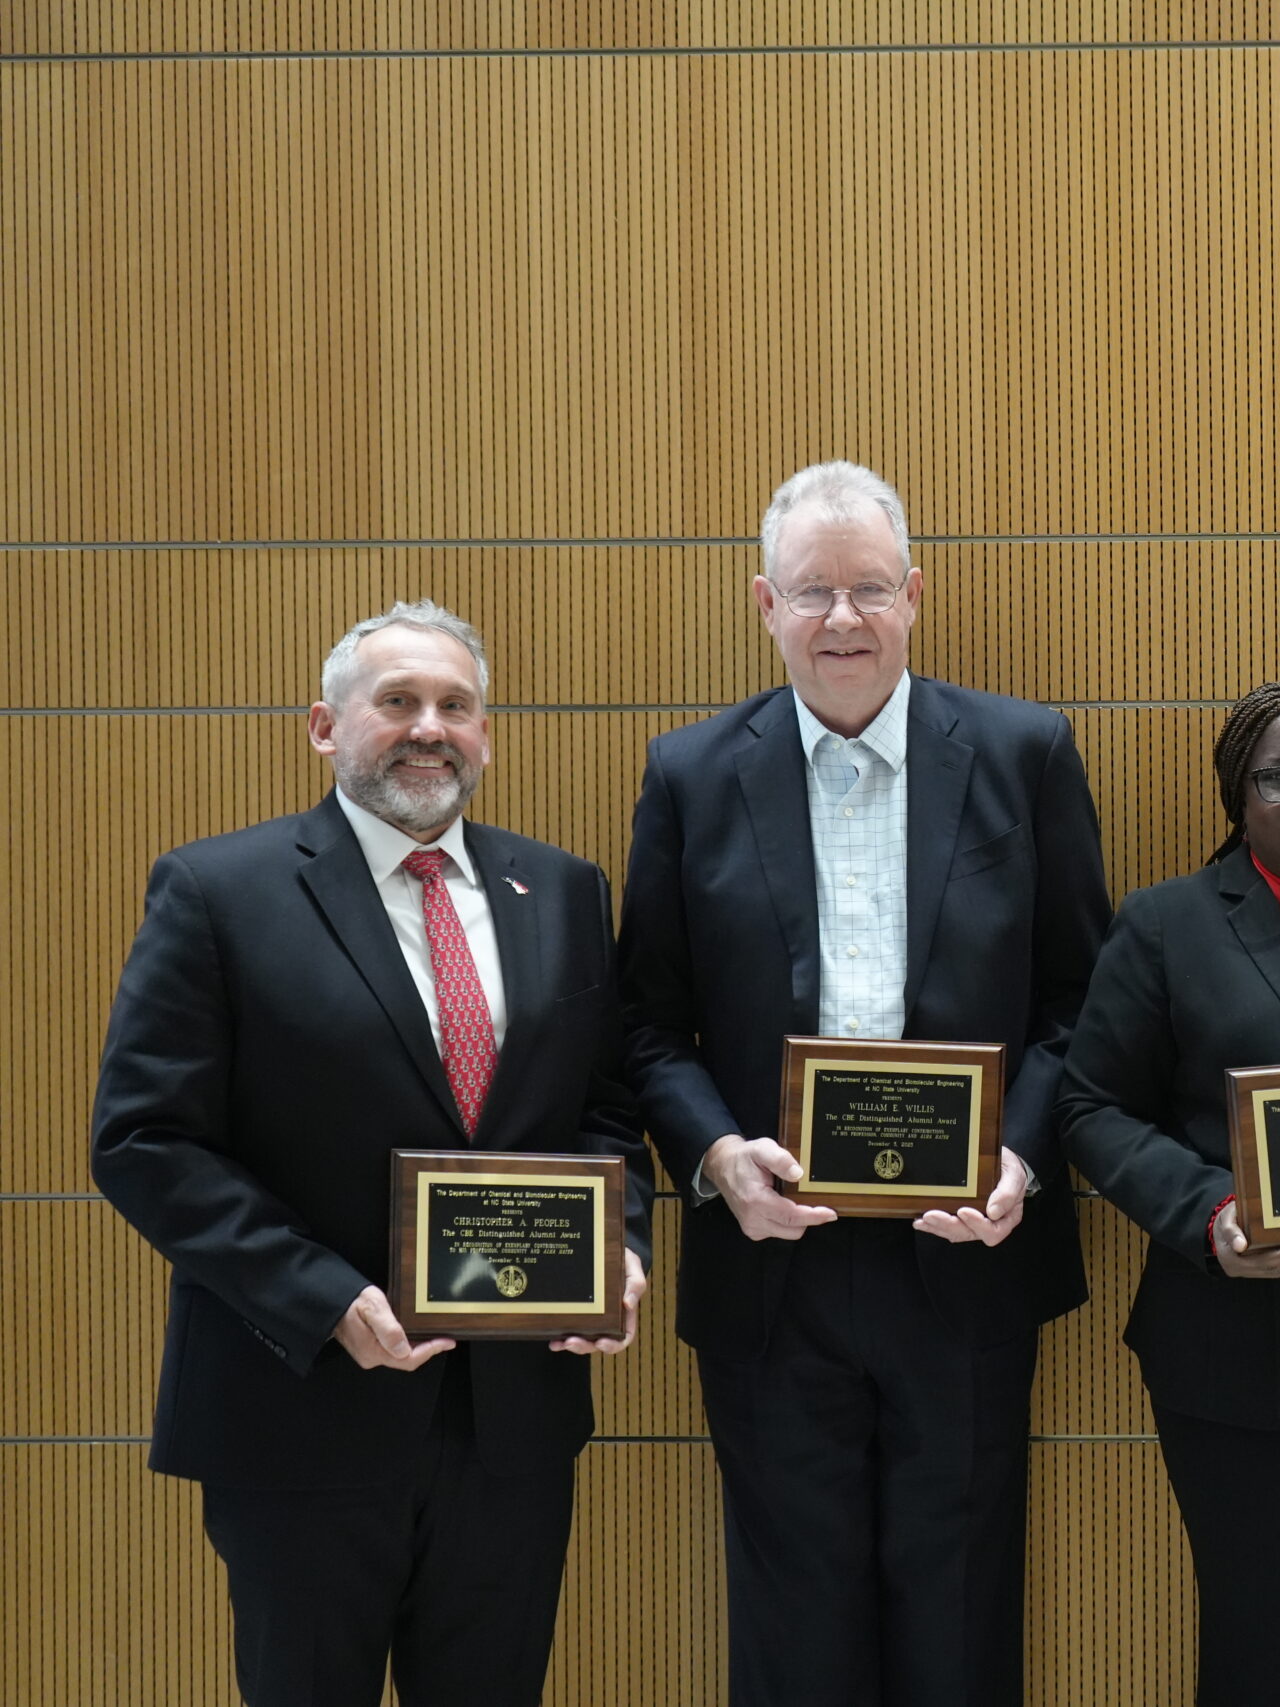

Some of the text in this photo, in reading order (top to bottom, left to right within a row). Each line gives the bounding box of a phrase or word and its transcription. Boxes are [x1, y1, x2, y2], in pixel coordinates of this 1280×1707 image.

[937, 1080, 964, 1088] Engineering
[849, 1102, 887, 1111] WILLIAM
[905, 1104, 934, 1113] WILLIS
[859, 1114, 903, 1123] Distinguished
[558, 1192, 586, 1200] Engineering
[453, 1216, 513, 1226] CHRISTOPHER
[534, 1218, 570, 1227] PEOPLES
[460, 1229, 474, 1237] CBE
[478, 1229, 524, 1238] Distinguished
